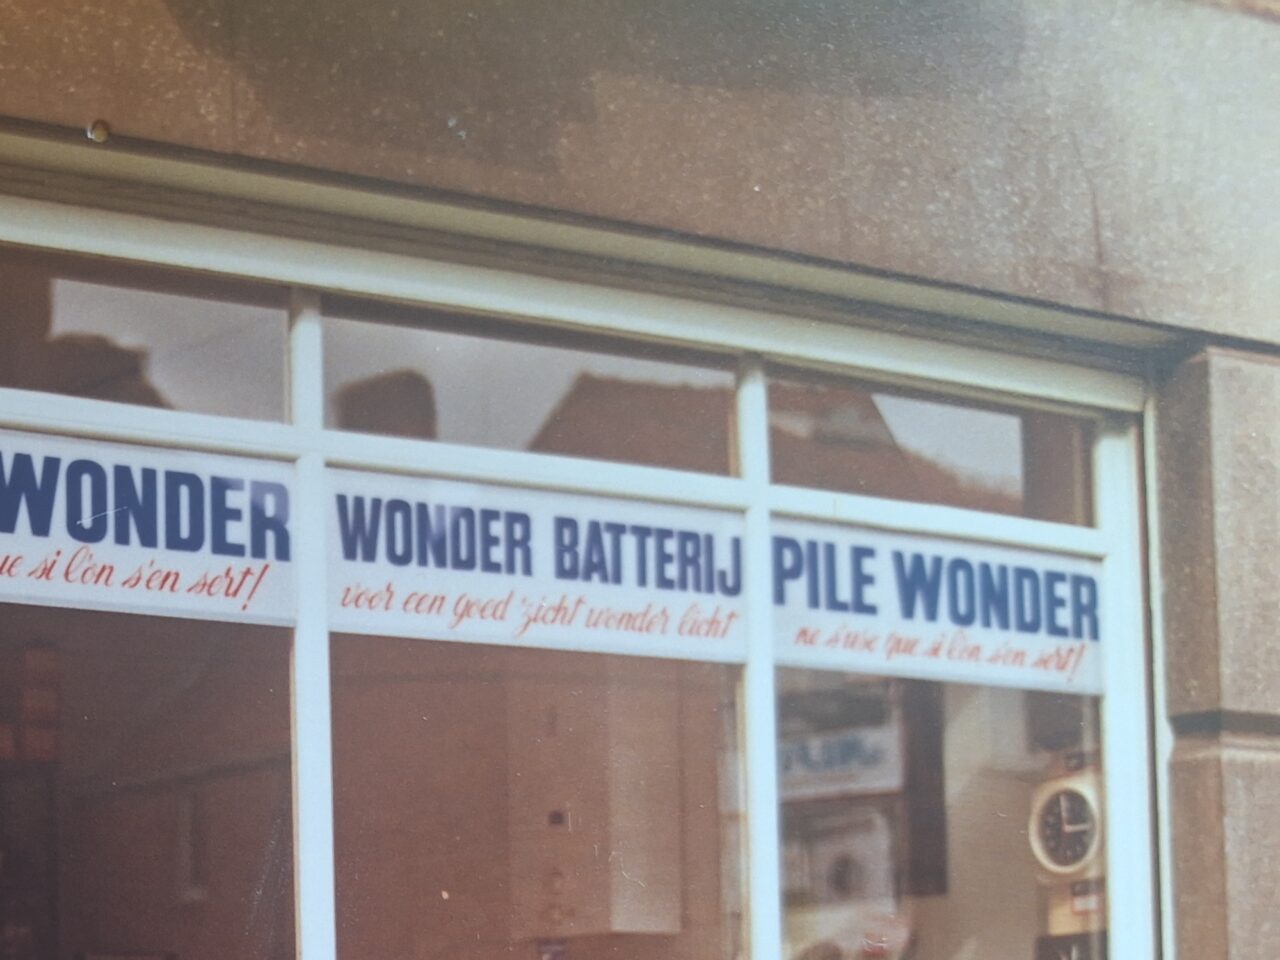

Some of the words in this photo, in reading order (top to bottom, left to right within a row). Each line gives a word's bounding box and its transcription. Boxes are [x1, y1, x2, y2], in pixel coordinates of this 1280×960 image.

[28, 551, 61, 579] si
[64, 545, 113, 587] l'on
[122, 559, 179, 593] s'en
[188, 564, 269, 610] sert!
[336, 494, 532, 577] WONDER
[554, 515, 743, 597] BATTERIJ
[340, 583, 394, 609] voor
[403, 590, 445, 615] een
[449, 591, 514, 629] goed
[586, 604, 669, 635] wonder
[677, 607, 738, 638] licht
[772, 535, 878, 616] PILE
[892, 550, 1099, 641] WONDER
